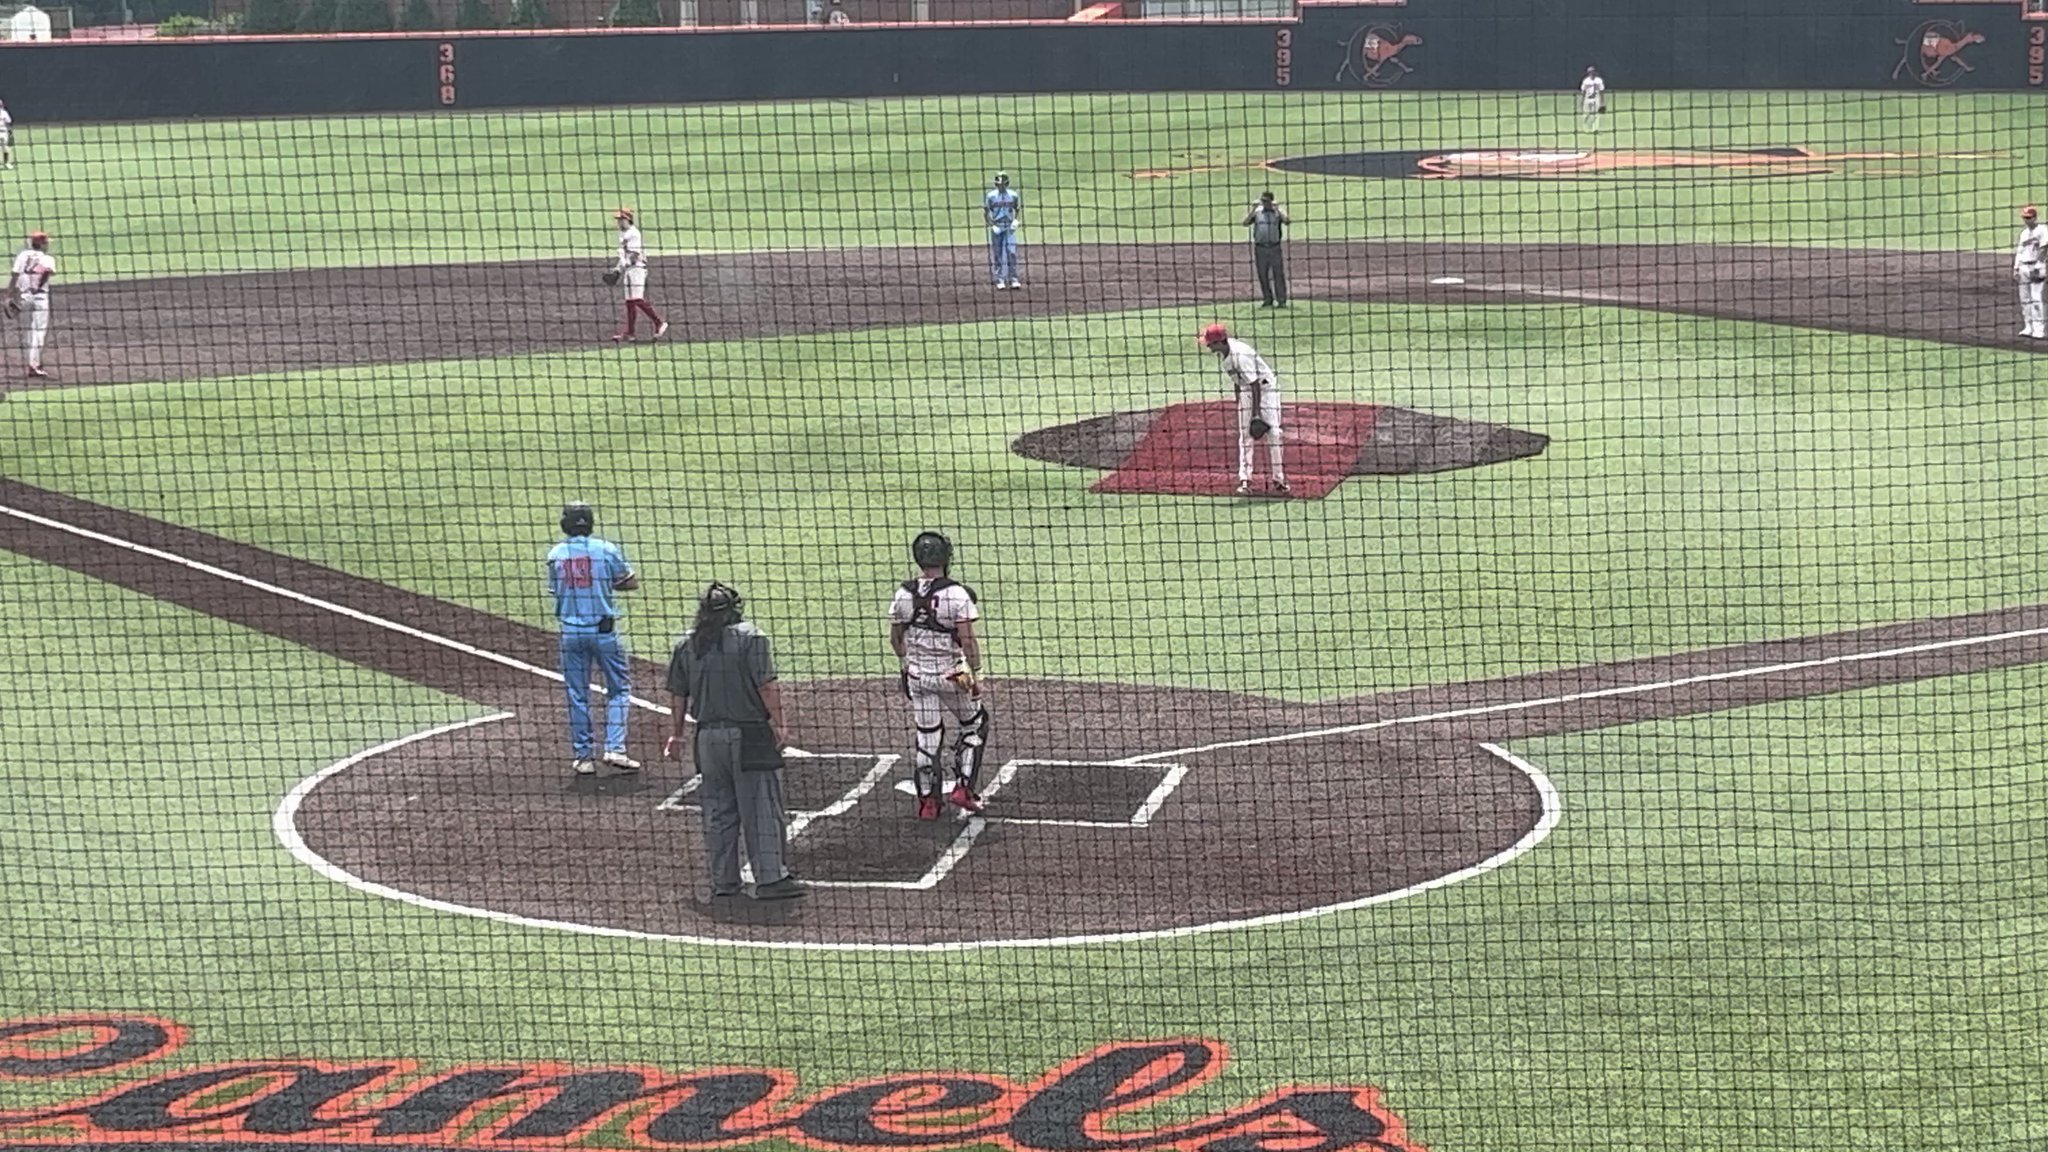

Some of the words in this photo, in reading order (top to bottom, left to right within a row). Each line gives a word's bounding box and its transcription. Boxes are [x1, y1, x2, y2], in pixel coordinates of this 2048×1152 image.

[439, 43, 455, 105] 368
[1276, 29, 1292, 86] 395
[2029, 27, 2046, 85] 395
